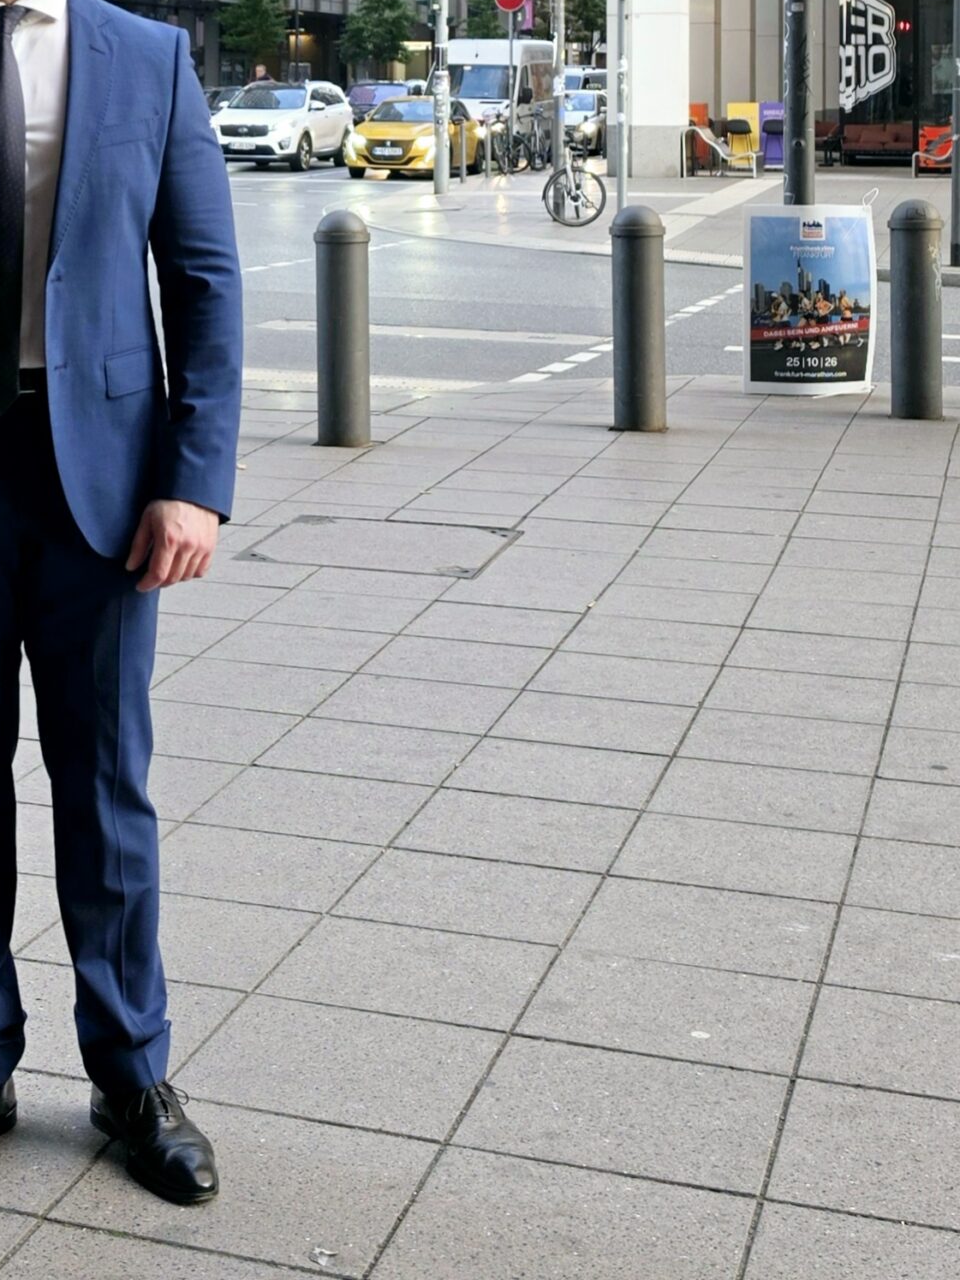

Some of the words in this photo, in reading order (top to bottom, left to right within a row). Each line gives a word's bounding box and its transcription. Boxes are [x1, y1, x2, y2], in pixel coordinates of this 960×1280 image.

[786, 357, 800, 367] 25
[807, 357, 819, 367] 10
[825, 357, 838, 367] 26
